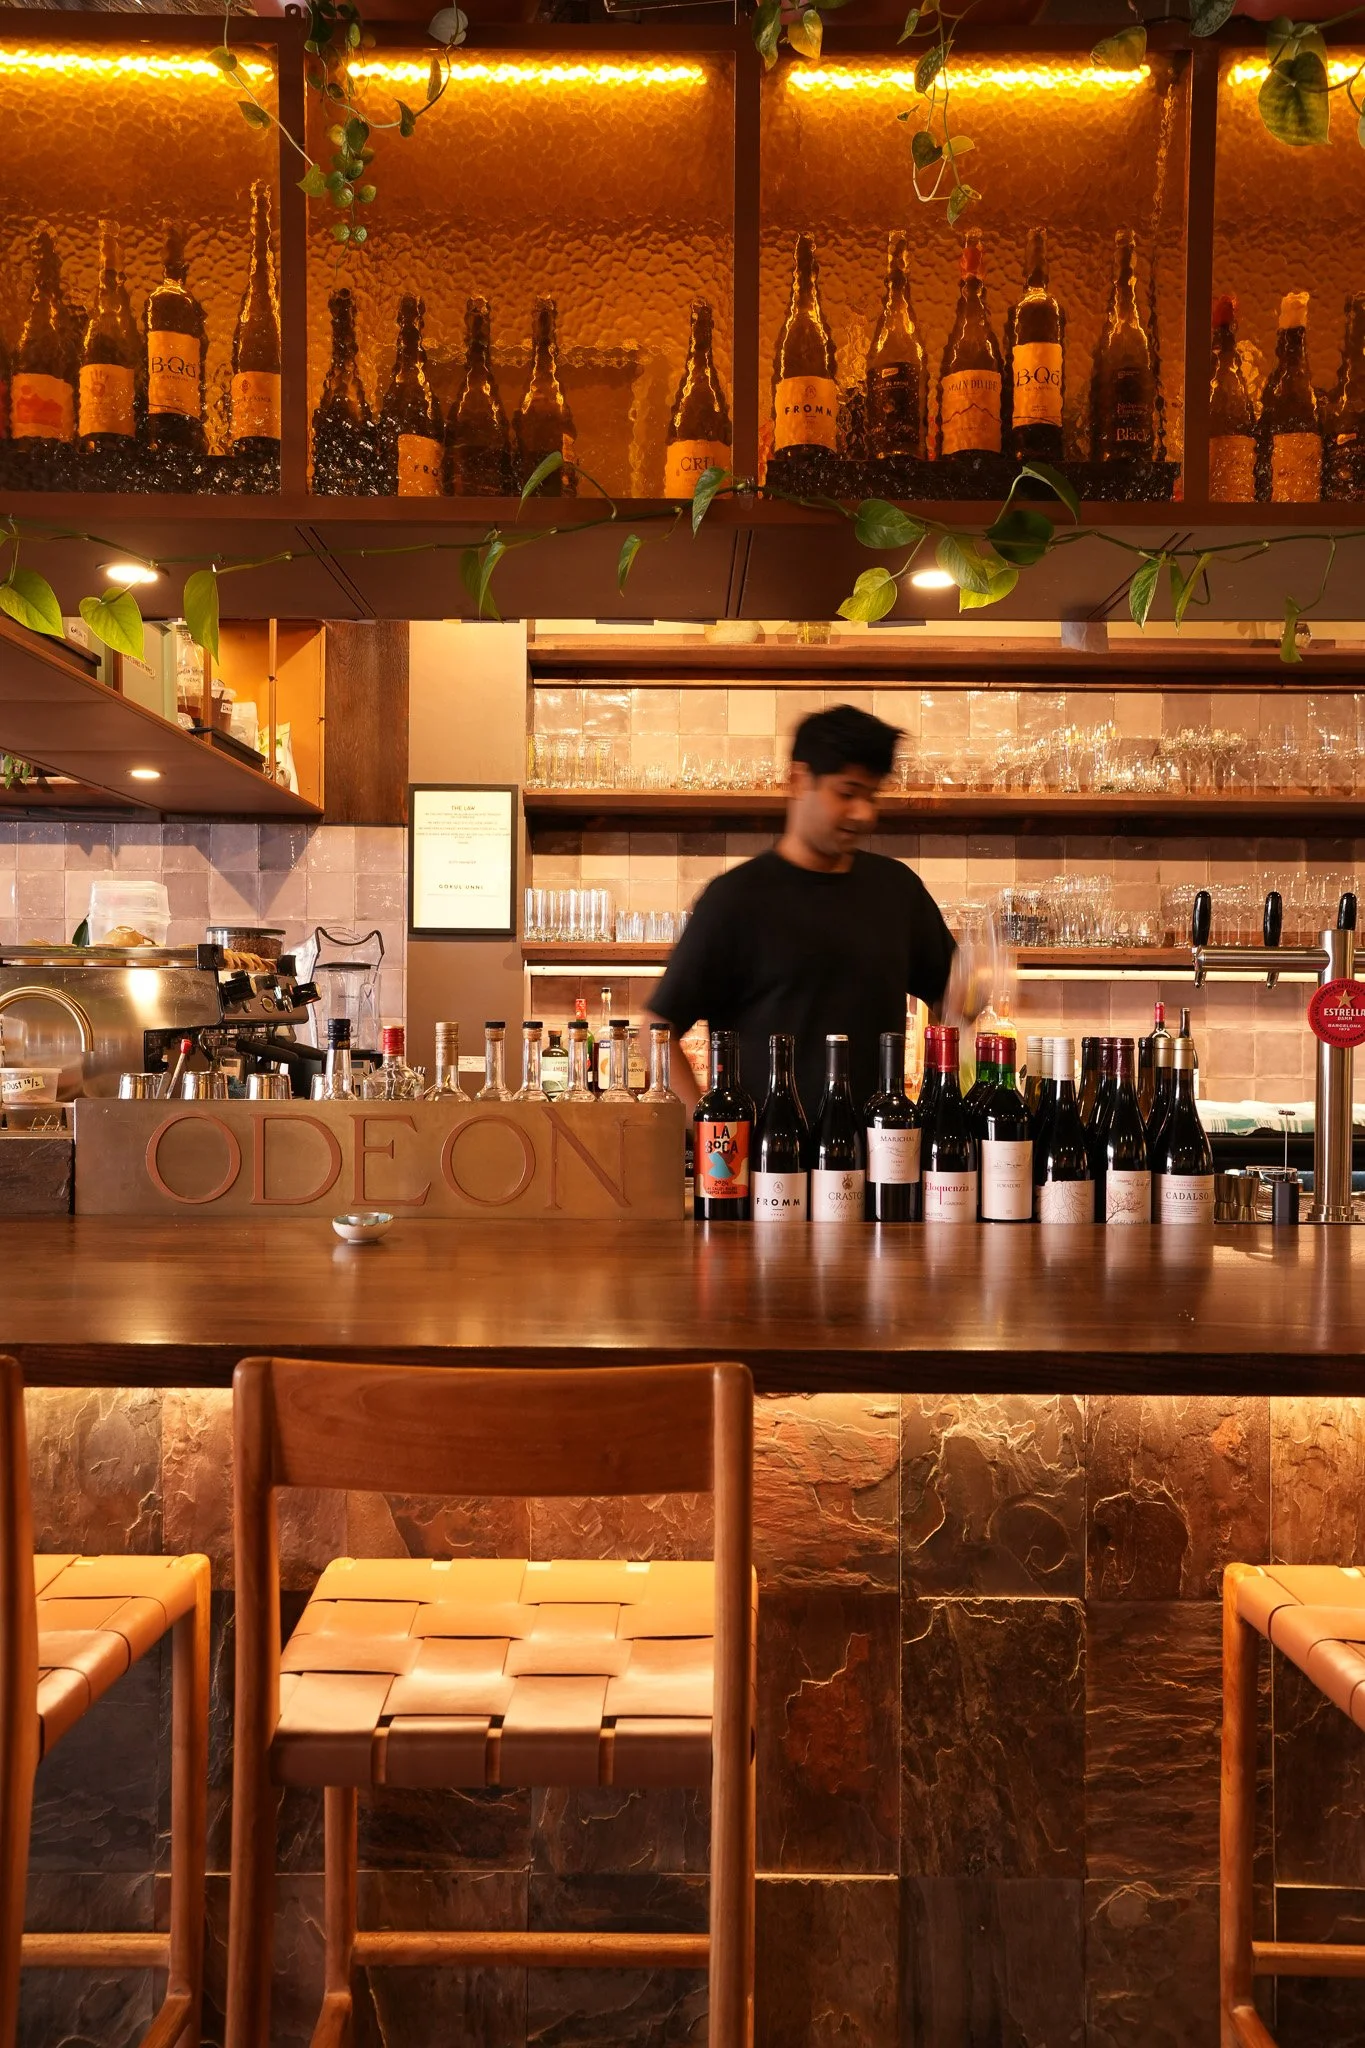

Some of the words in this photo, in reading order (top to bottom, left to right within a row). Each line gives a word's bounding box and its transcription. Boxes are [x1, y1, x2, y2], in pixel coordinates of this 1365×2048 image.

[1323, 1008, 1365, 1017] ESTRELLA
[713, 1125, 730, 1139] LA
[145, 1106, 651, 1211] ODEON
[828, 1191, 863, 1201] CRASTO
[1165, 1191, 1209, 1201] CADALSO
[756, 1197, 801, 1206] FROMM
